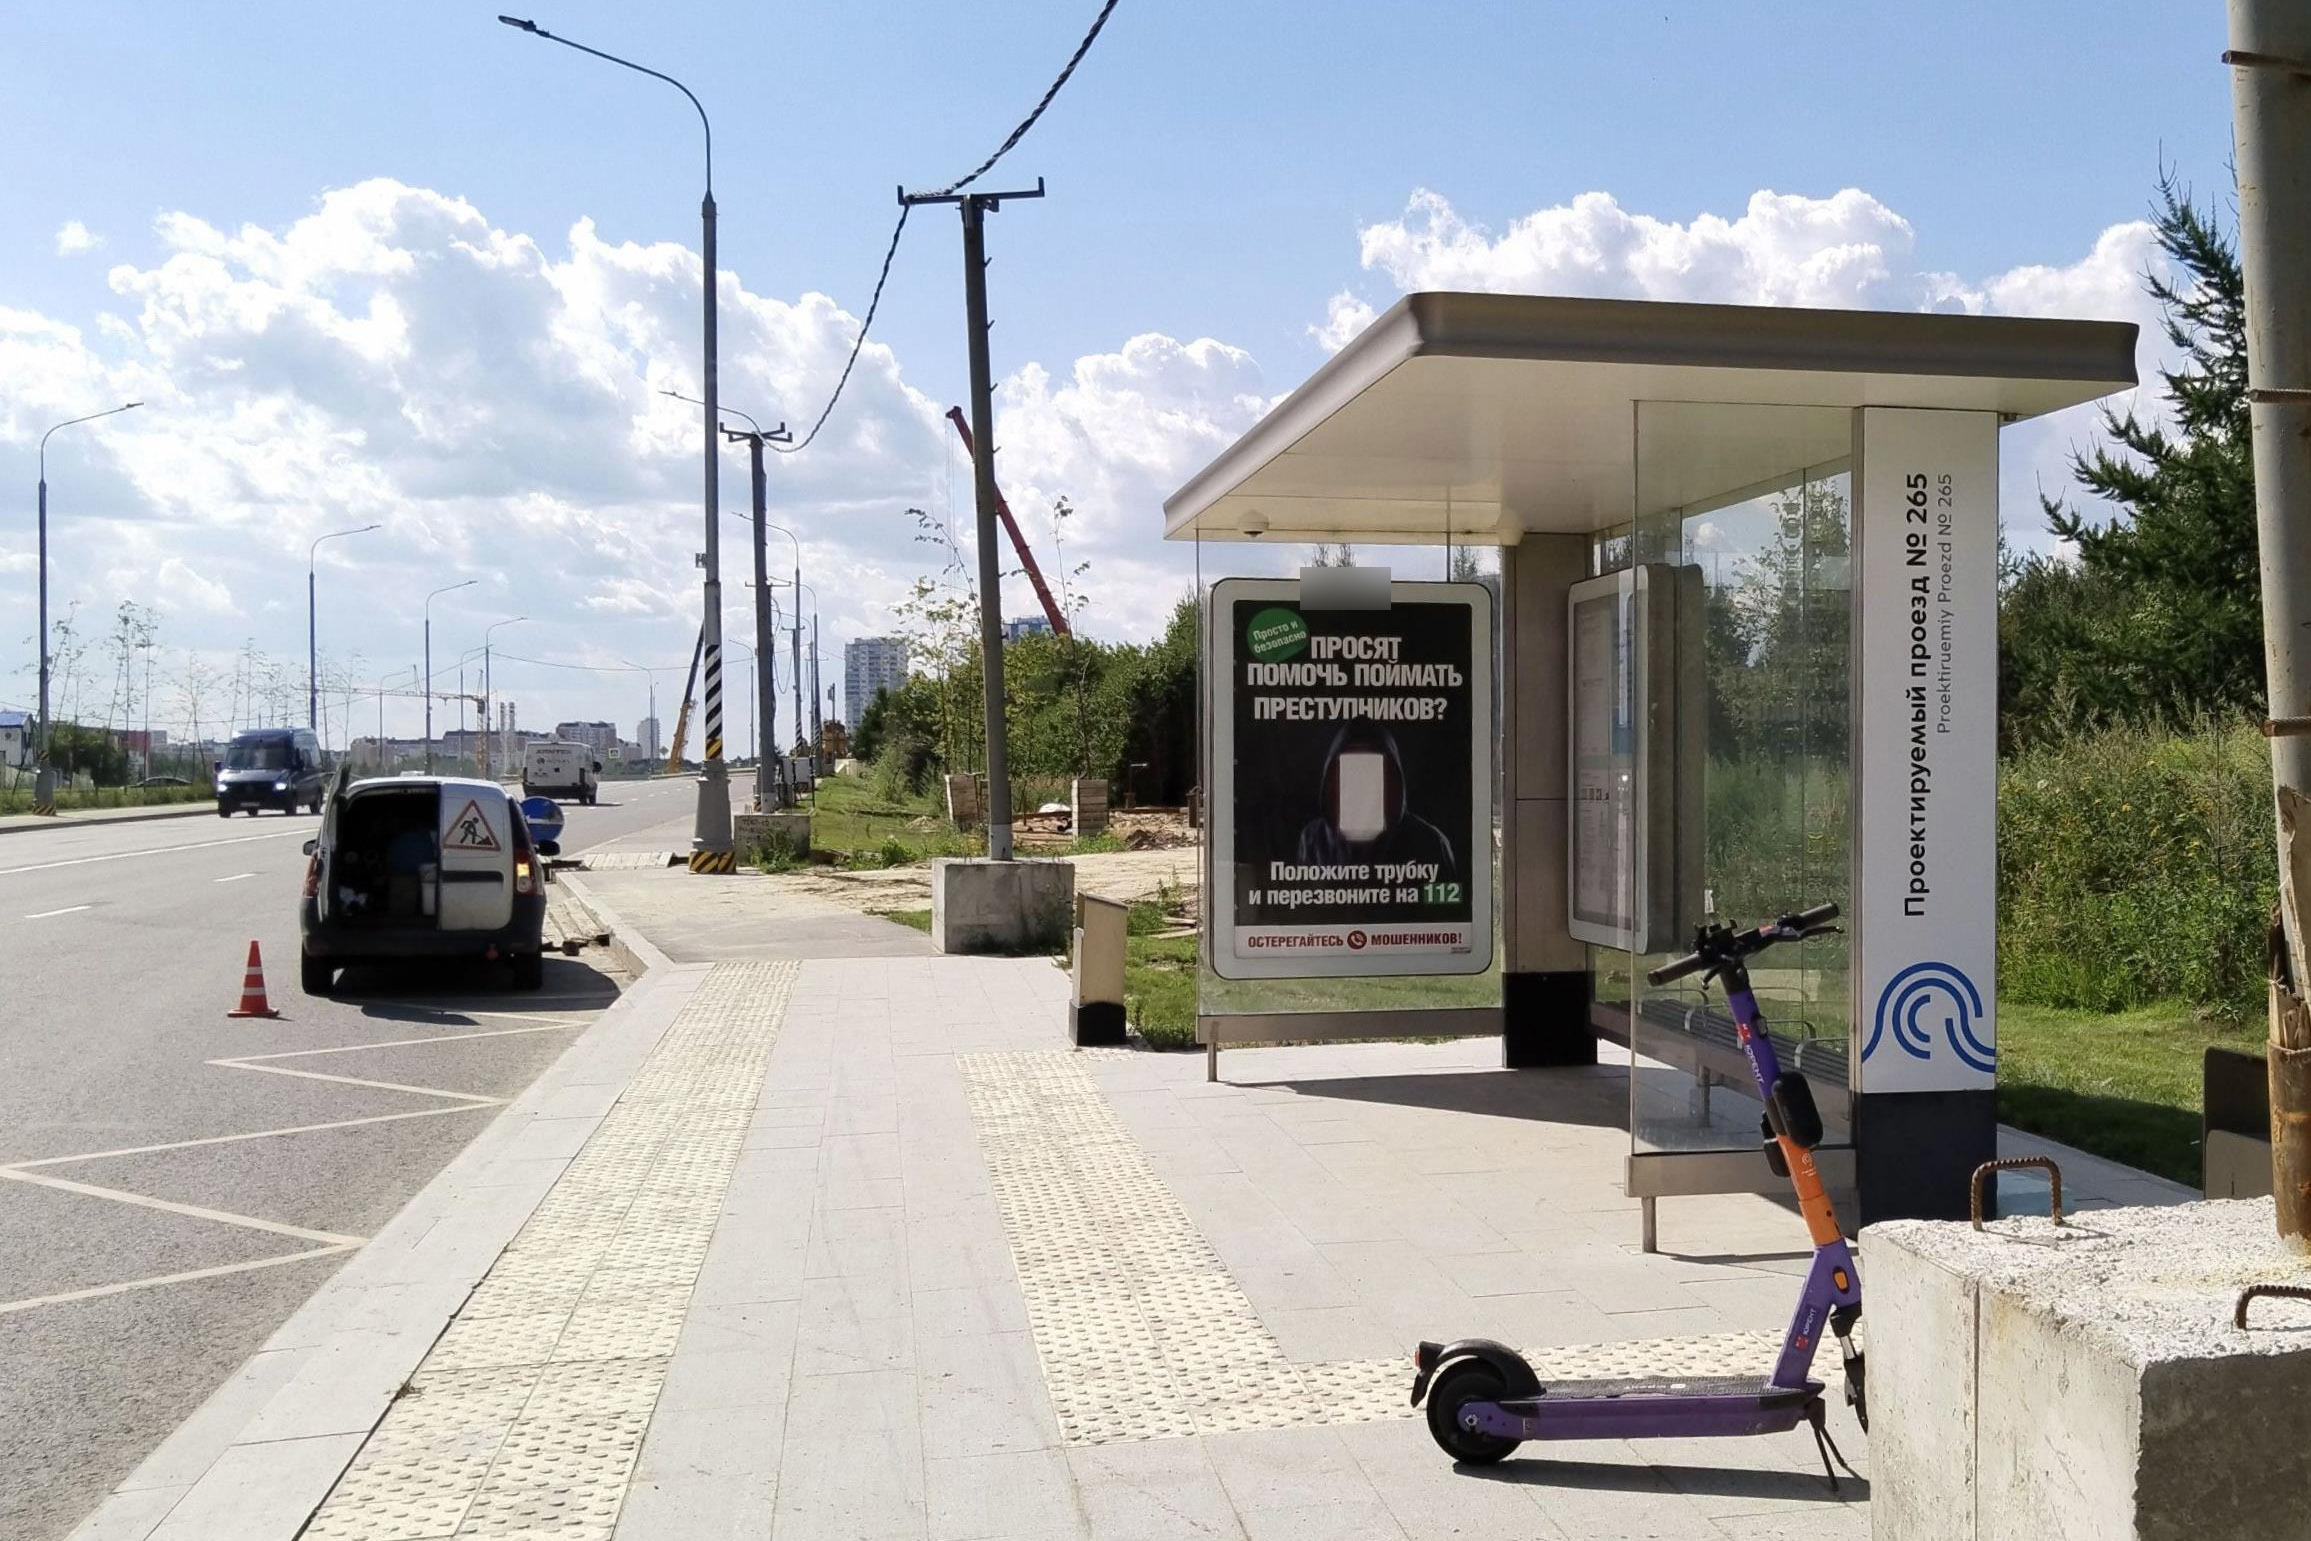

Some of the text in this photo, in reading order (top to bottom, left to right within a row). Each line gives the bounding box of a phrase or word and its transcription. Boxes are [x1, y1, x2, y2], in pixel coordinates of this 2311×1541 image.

[1936, 473, 1955, 734] Proektiruemiy Proezd № 265
[1252, 620, 1299, 642] Просто и
[1253, 630, 1307, 654] безопасно
[1311, 636, 1402, 660] ПРОСЯТ
[1247, 659, 1464, 687] ПОМОЧЬ ПОЙМАТЬ
[1904, 472, 1931, 917] Проектируемый проезд № 265
[1253, 696, 1448, 720] ПРЕСТУПНИКОВ?
[1270, 860, 1439, 884] Положите трубку
[1248, 882, 1461, 910] и перезвоните на 112
[1247, 932, 1463, 948] ОСТЕРЕГАЙТЕСЬ МОШЕННИКОВ!
[1743, 1044, 1766, 1085] ЮРЕНТ
